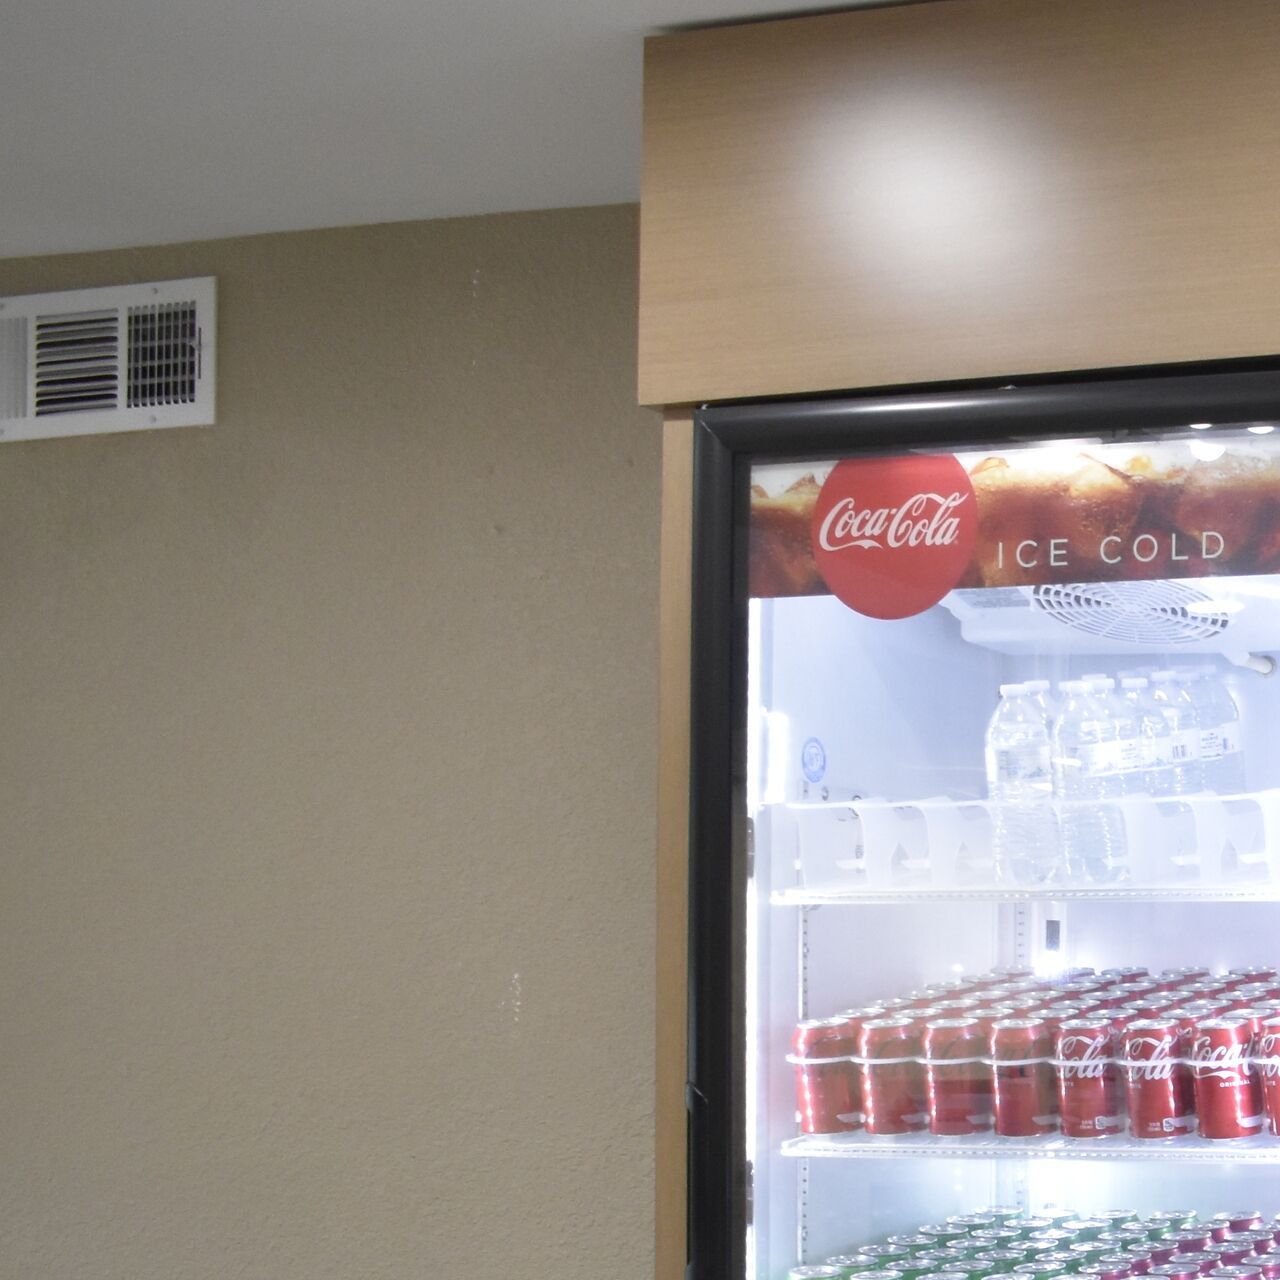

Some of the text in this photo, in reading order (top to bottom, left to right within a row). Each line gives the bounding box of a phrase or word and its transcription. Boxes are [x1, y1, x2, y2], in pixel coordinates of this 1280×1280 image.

[818, 492, 968, 552] Coca-Cola
[998, 531, 1225, 569] ICE COLD
